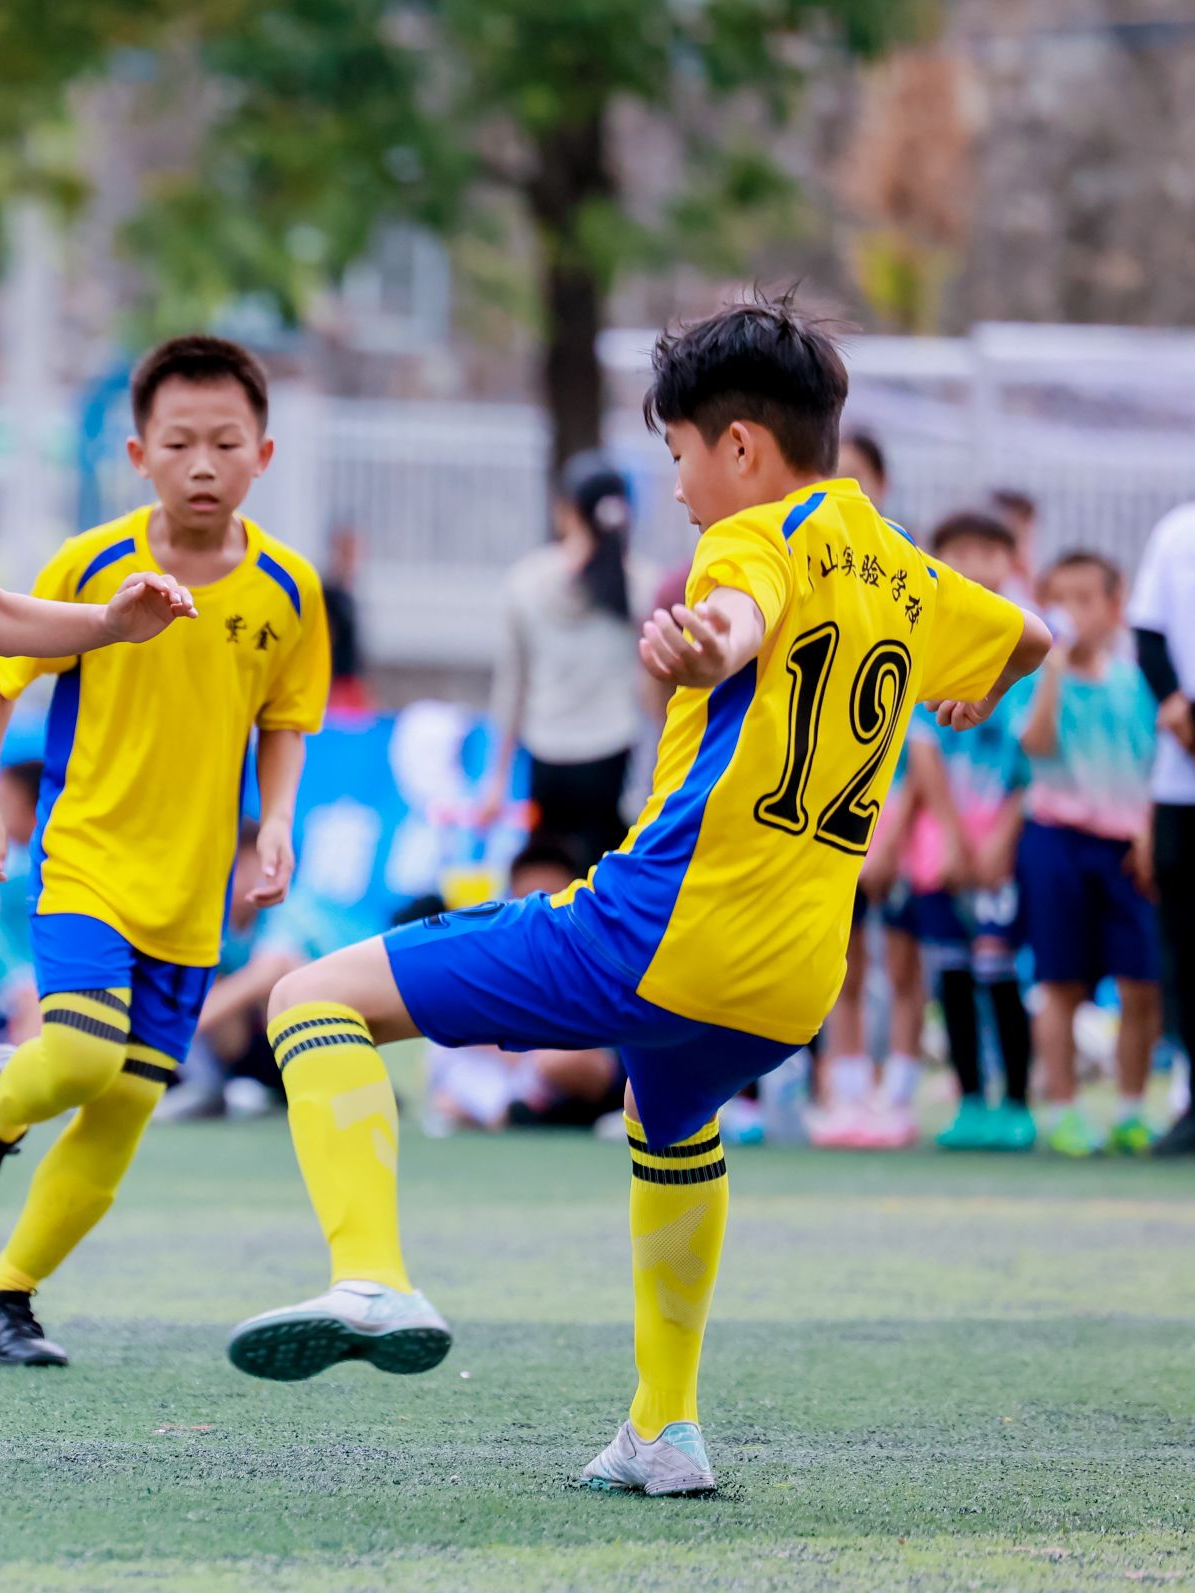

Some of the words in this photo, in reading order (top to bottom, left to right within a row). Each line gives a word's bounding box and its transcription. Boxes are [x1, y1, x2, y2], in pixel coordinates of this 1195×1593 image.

[807, 543, 923, 634] 山实验学校
[753, 621, 912, 857] 12
